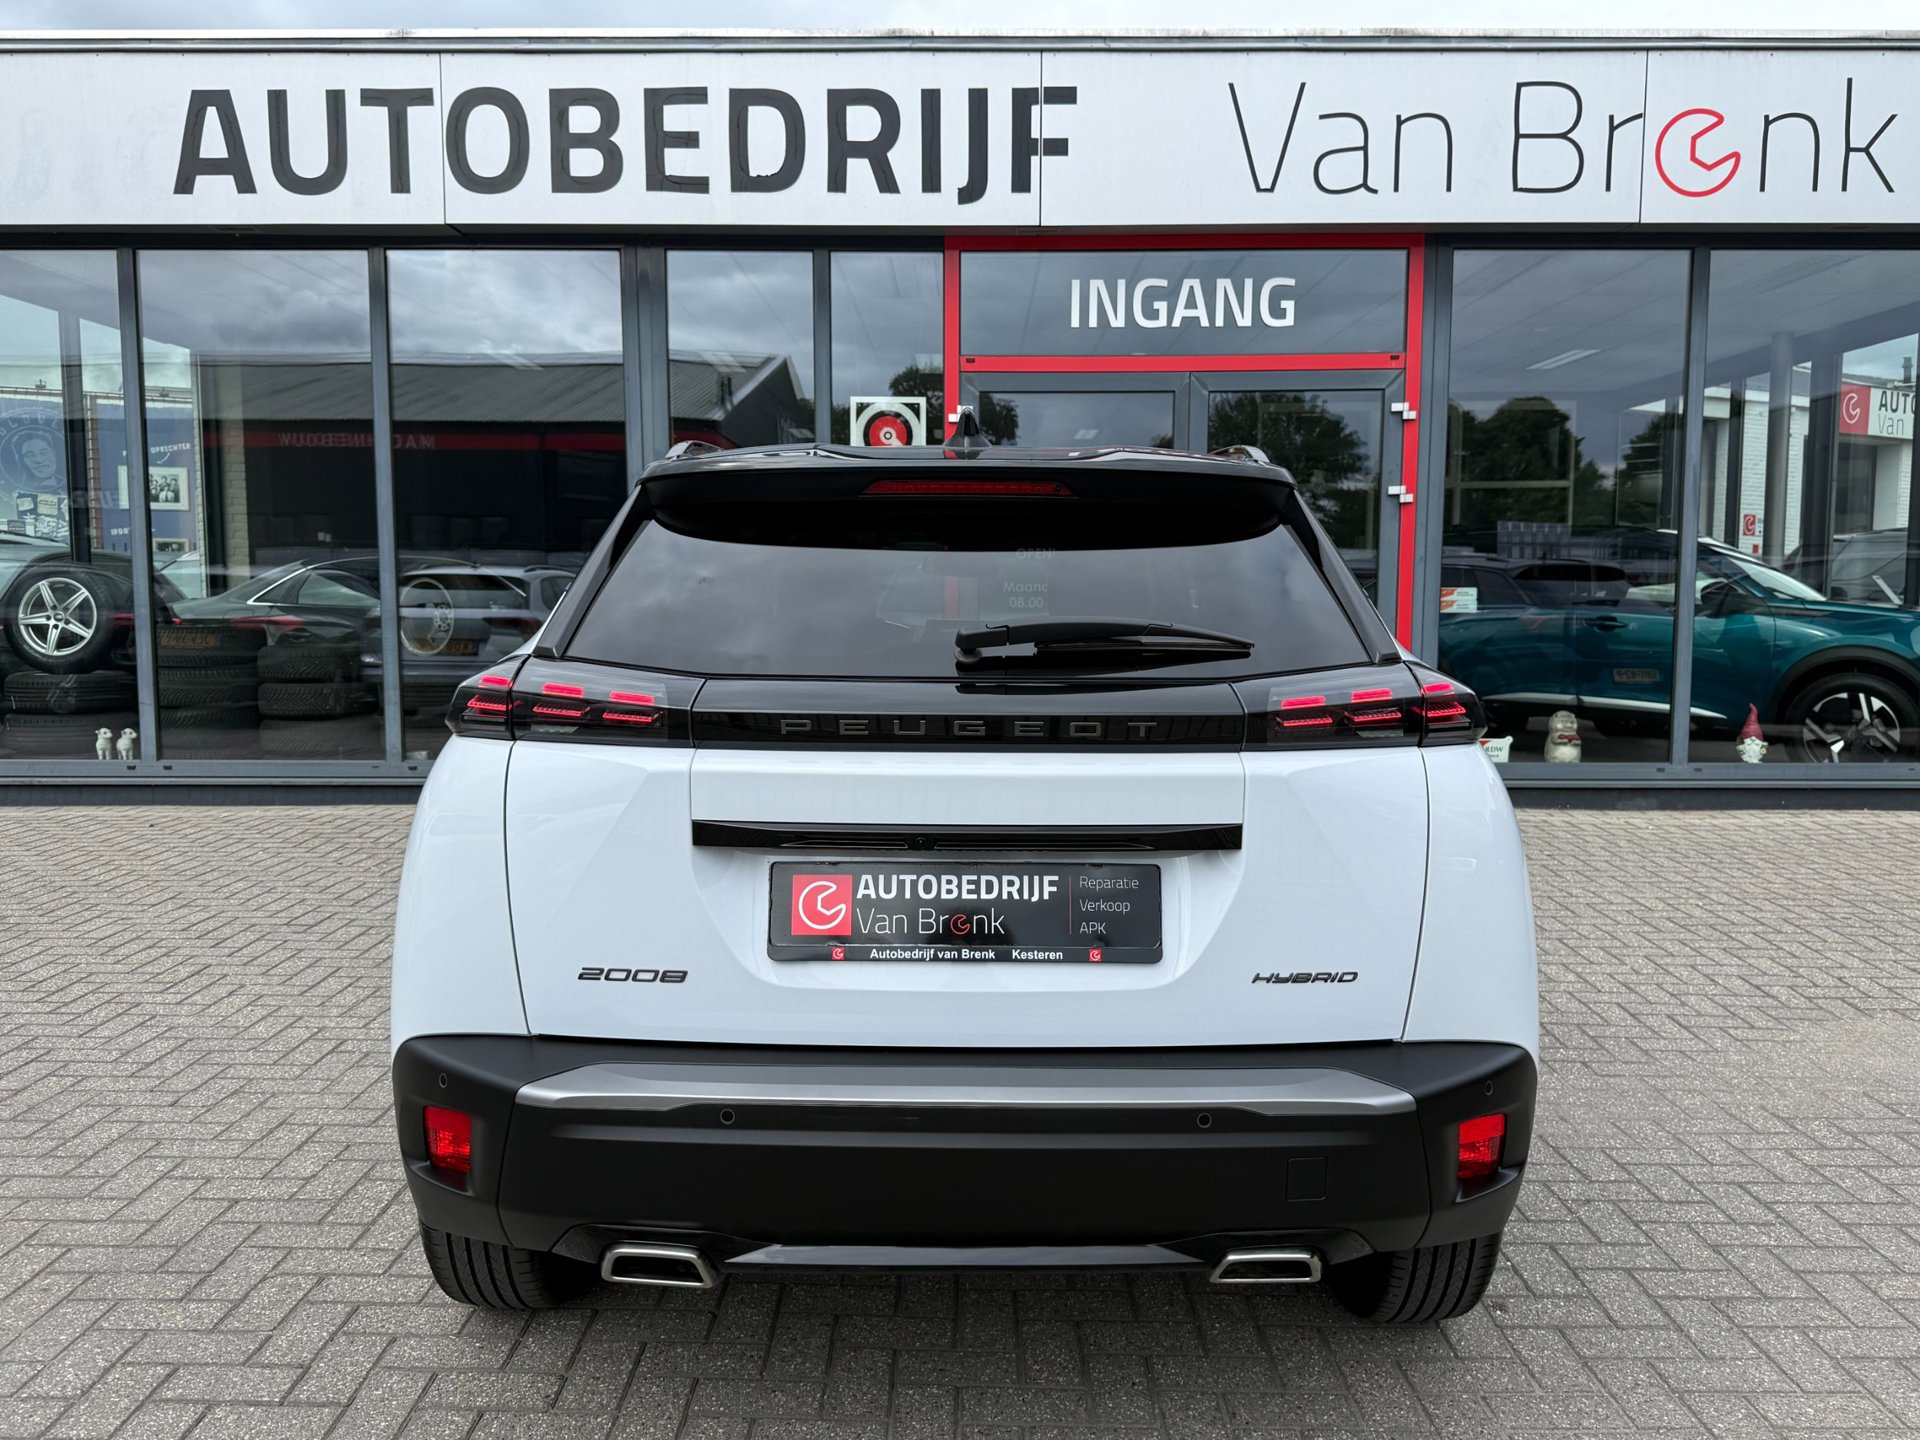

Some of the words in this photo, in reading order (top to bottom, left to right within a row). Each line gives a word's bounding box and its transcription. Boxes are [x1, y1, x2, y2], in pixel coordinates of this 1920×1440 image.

[173, 85, 1078, 206] AUTOBEDRIJF
[1228, 81, 1454, 195] Van
[1069, 276, 1297, 330] INGANG
[1877, 413, 1904, 436] Van
[1008, 596, 1044, 608] 08.00
[780, 718, 1158, 738] PEUGEOT
[856, 874, 1060, 902] AUTOBEDRIJF
[1079, 875, 1140, 892] Reparatie
[1079, 898, 1132, 915] Verkoop
[856, 907, 908, 934] Van
[1079, 921, 1107, 935] APK
[870, 948, 936, 961] Autobedrijf
[937, 951, 958, 960] van
[961, 949, 996, 960] Brenk
[1012, 949, 1063, 960] Kesteren
[577, 966, 689, 984] 2008
[1251, 971, 1359, 984] HYBRID
